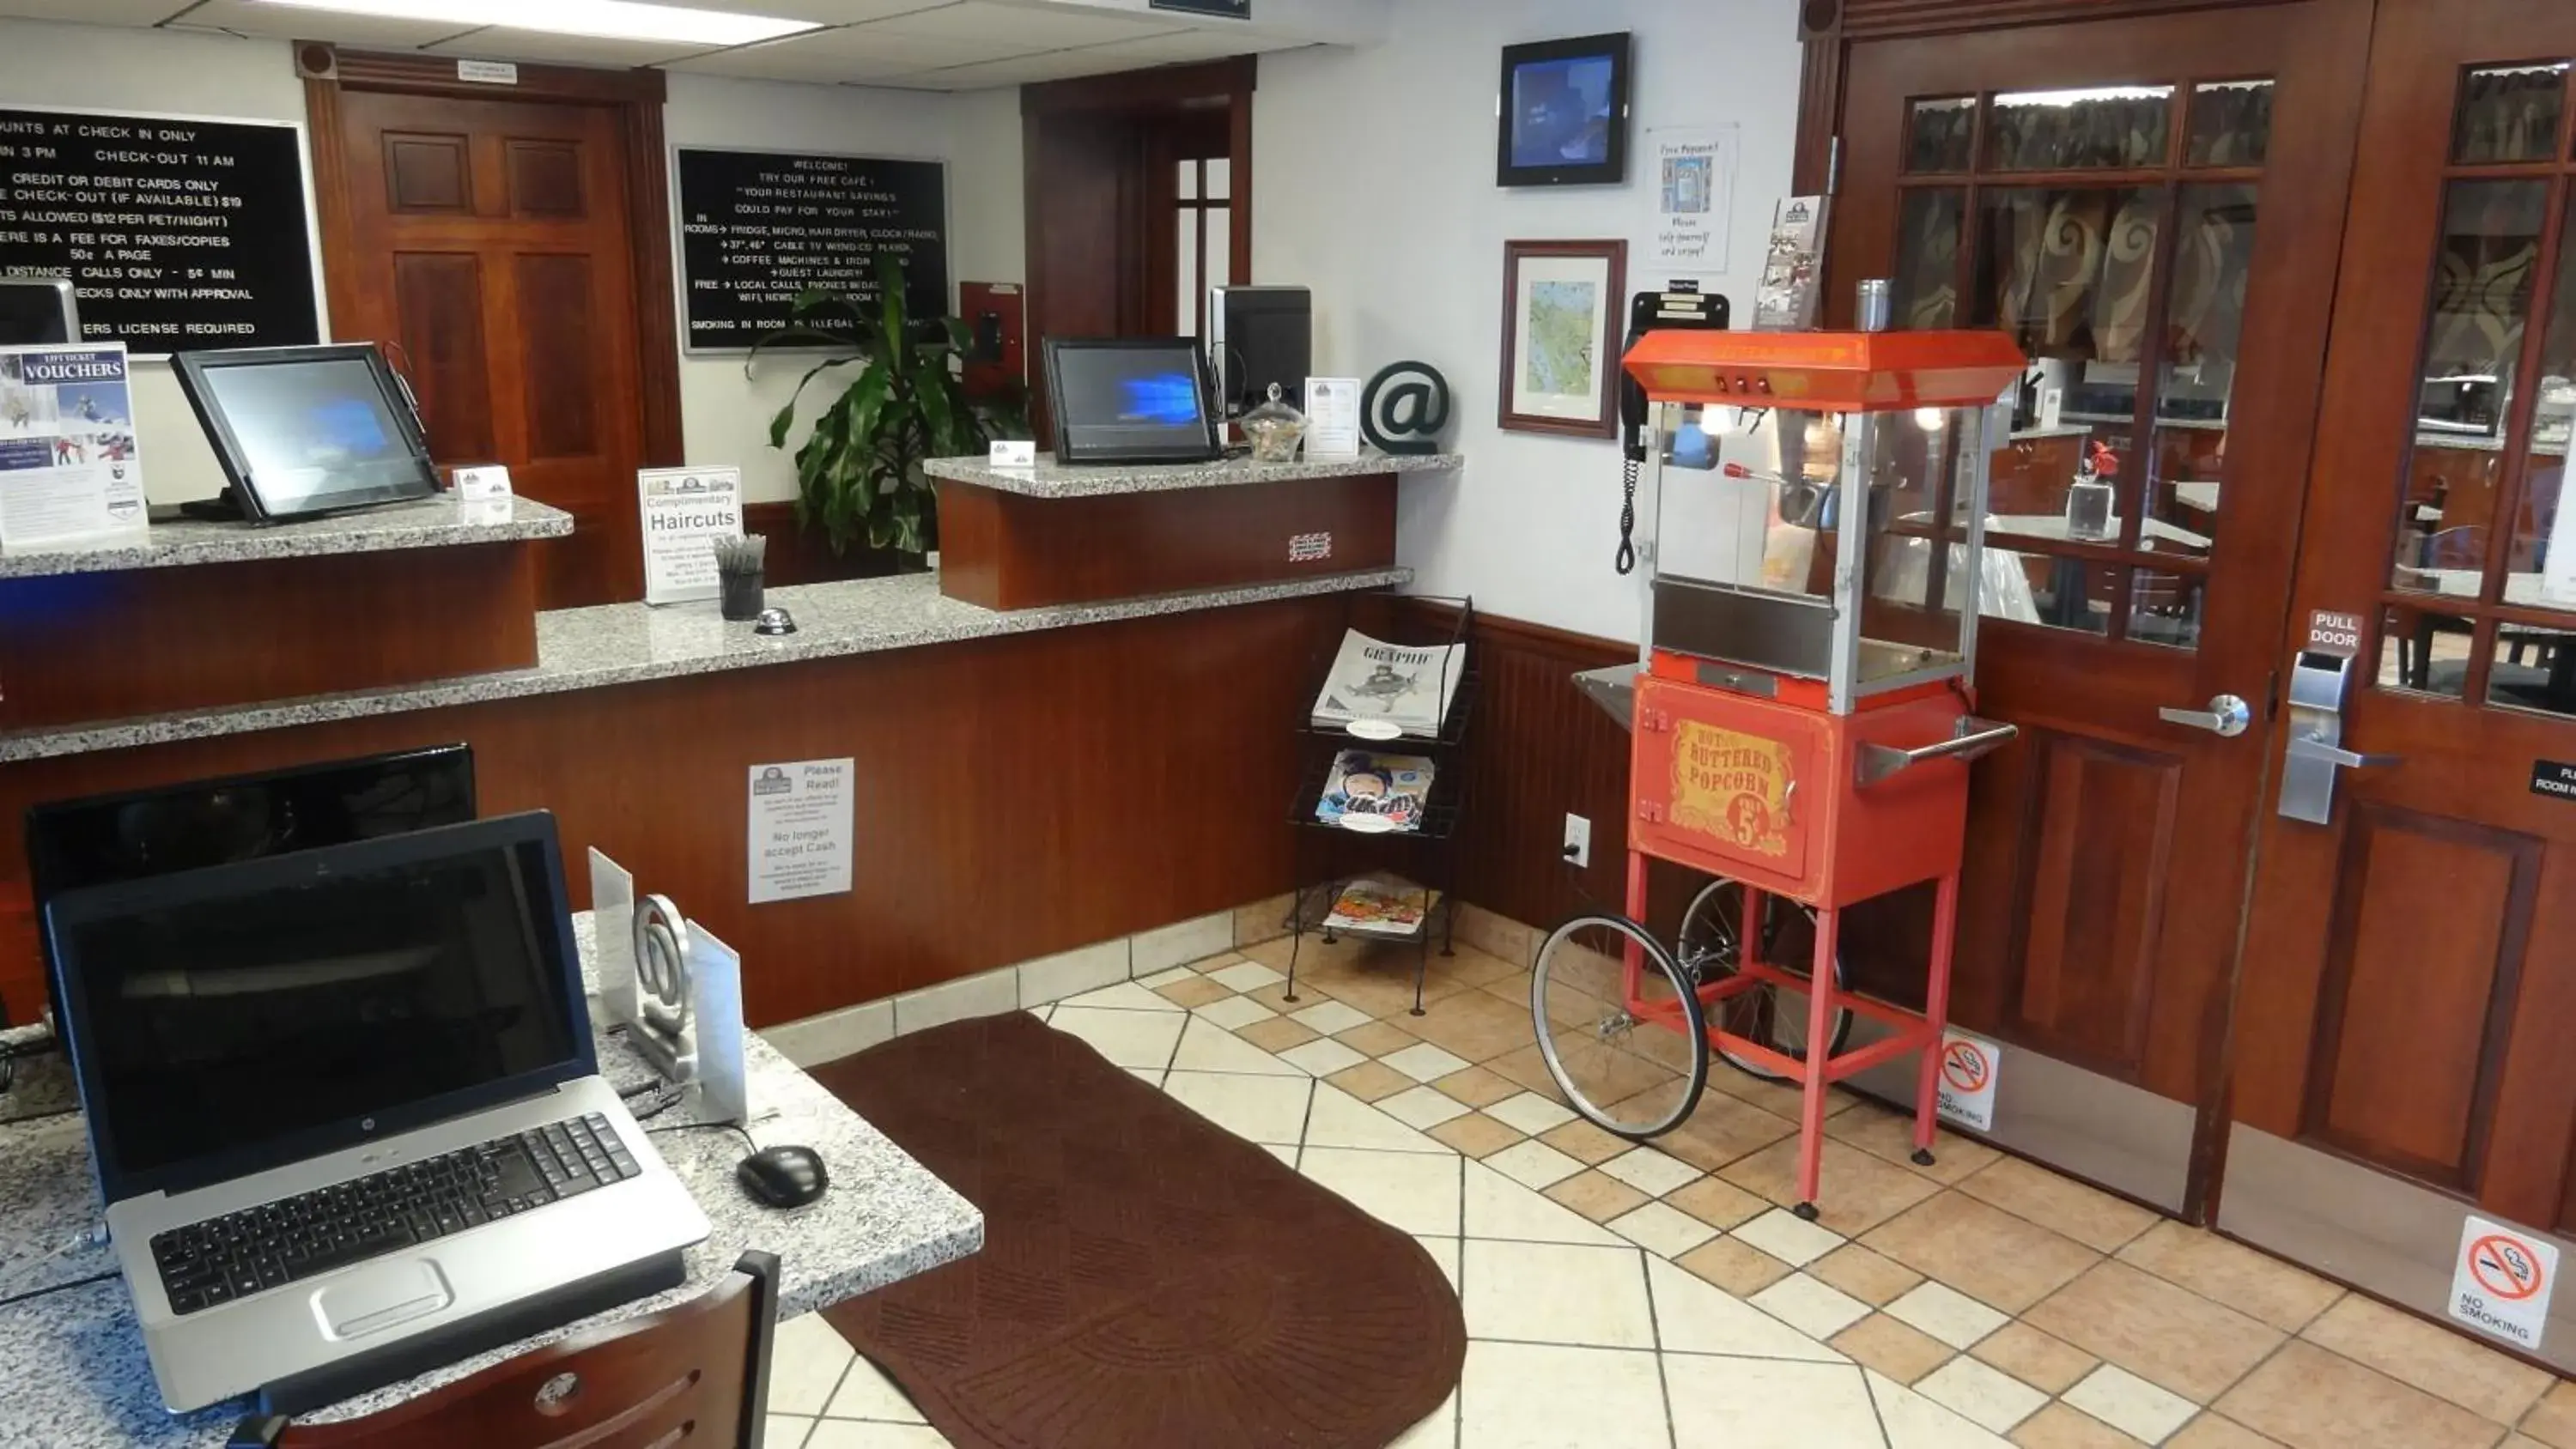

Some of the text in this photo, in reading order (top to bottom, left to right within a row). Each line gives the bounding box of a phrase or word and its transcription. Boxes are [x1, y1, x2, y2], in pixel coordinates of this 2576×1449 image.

[53, 124, 70, 135] AT
[78, 125, 131, 137] CHECK
[159, 130, 196, 142] ONLY
[21, 147, 32, 158] 3
[35, 147, 57, 159] PM
[94, 149, 189, 165] CHECK-OUT
[213, 155, 234, 167] AM
[12, 173, 219, 191] CREDIT OR DEBIT CARDS ONLY
[734, 203, 770, 215] COULD
[797, 206, 818, 216] FOR
[825, 208, 854, 217] YOUR
[22, 211, 88, 222] ALLOWED
[118, 213, 145, 224] PER
[684, 224, 719, 233] ROOMS
[33, 233, 48, 243] IS
[52, 233, 63, 243] A
[70, 233, 95, 245] FEE
[100, 233, 128, 246] FOR
[105, 250, 114, 260] A
[118, 250, 152, 261] PAGE
[732, 256, 771, 265] COFFEE
[6, 265, 72, 277] DISTANCE
[82, 267, 123, 278] CALLS
[128, 268, 162, 279] ONLY
[210, 269, 235, 280] MIN
[779, 268, 811, 279] GUEST
[695, 279, 718, 289] FREE
[734, 281, 767, 289] LOCAL
[118, 288, 152, 300] ONLY
[154, 288, 188, 300] WITH
[191, 288, 253, 300] APPROVAL
[118, 324, 179, 335] LICENSE
[186, 323, 256, 335] REQUIRED
[691, 320, 735, 330] SMOKING
[24, 361, 122, 379] VOUCHERS
[647, 494, 731, 509] Complimentary
[651, 511, 736, 531] Haircuts
[2316, 614, 2356, 631] PULL
[2311, 629, 2357, 647] DOOR
[1690, 742, 1771, 774] BUTTERED
[804, 764, 843, 776] Please
[1689, 766, 1770, 800] POPCORN
[2536, 779, 2568, 793] ROOM
[774, 828, 829, 842] No longer
[764, 840, 837, 859] accept Cash
[2461, 1292, 2483, 1309] NO
[2458, 1303, 2530, 1340] SMOKING
